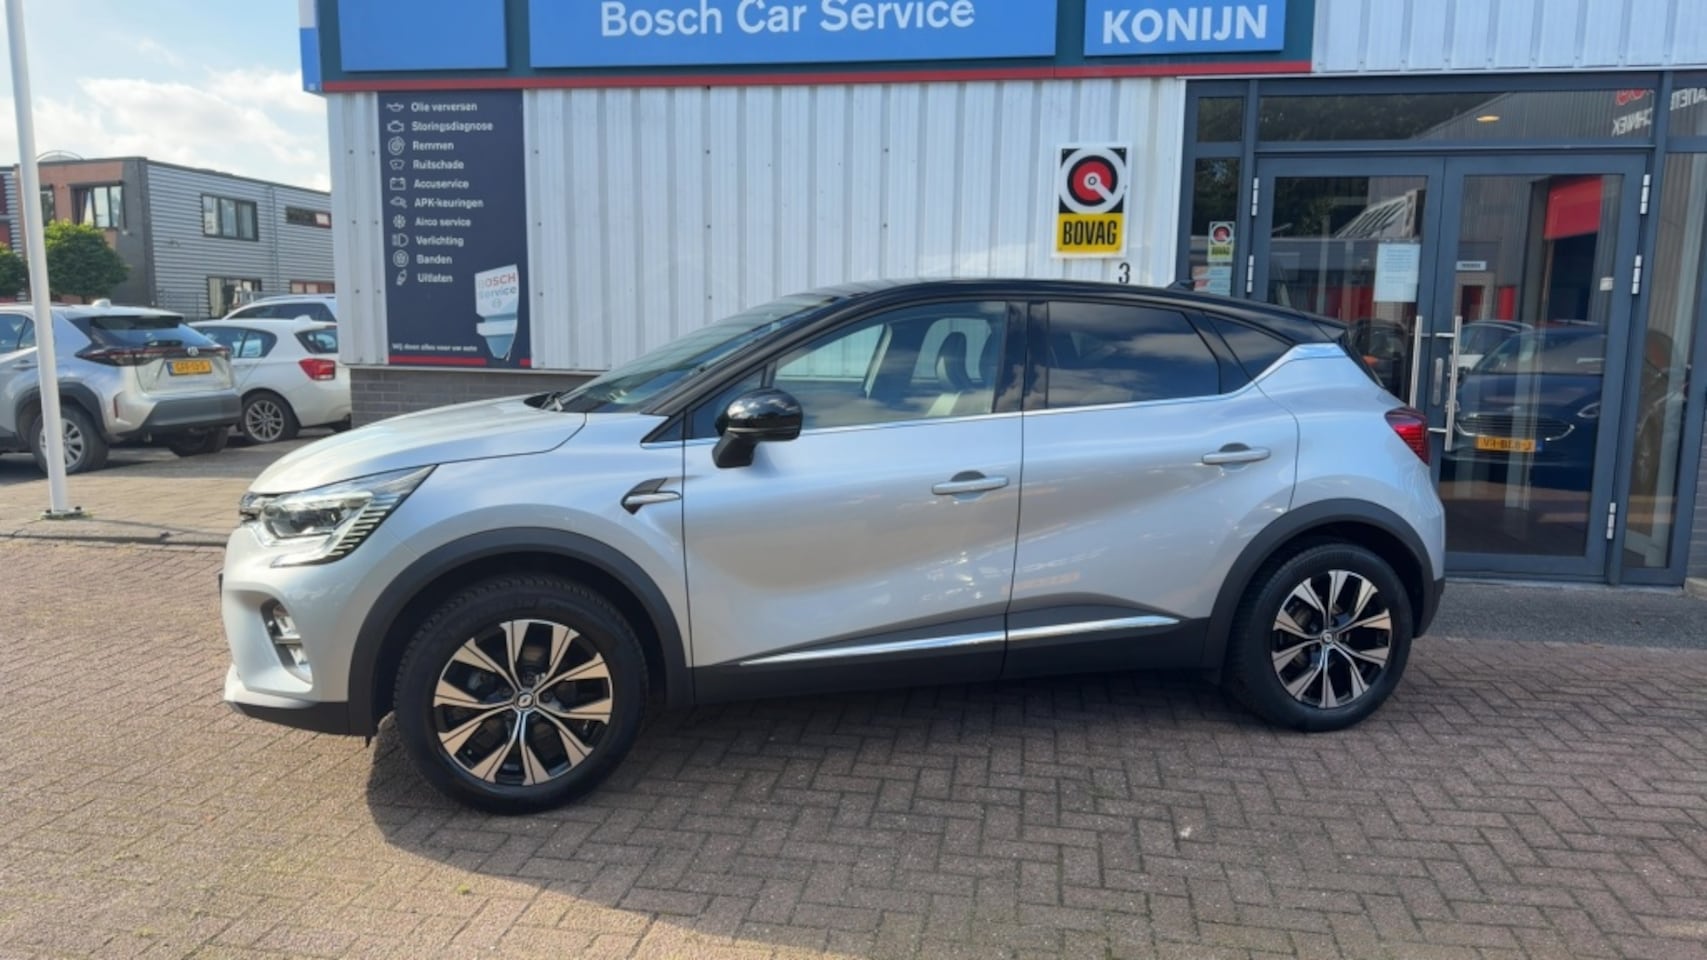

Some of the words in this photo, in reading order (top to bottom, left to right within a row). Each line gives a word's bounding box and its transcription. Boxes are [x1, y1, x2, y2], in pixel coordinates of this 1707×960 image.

[601, 0, 722, 37] Bosch
[736, 0, 807, 34] Car
[819, 0, 975, 31] Service
[1102, 5, 1267, 44] KONIJN
[411, 102, 430, 112] Olie
[432, 103, 478, 112] verversen
[411, 121, 494, 132] Storingsdiagnose
[412, 141, 455, 150] Remmen
[413, 160, 464, 169] Ruitschade
[414, 179, 469, 189] Accuservice
[414, 198, 484, 209] APK-keuringen
[415, 218, 438, 226] Airco
[440, 218, 471, 227] service
[1062, 220, 1117, 246] BOVAG
[415, 236, 464, 247] Verlichting
[416, 254, 453, 264] Banden
[417, 273, 453, 283] Uitlaten
[1118, 262, 1131, 284] 3
